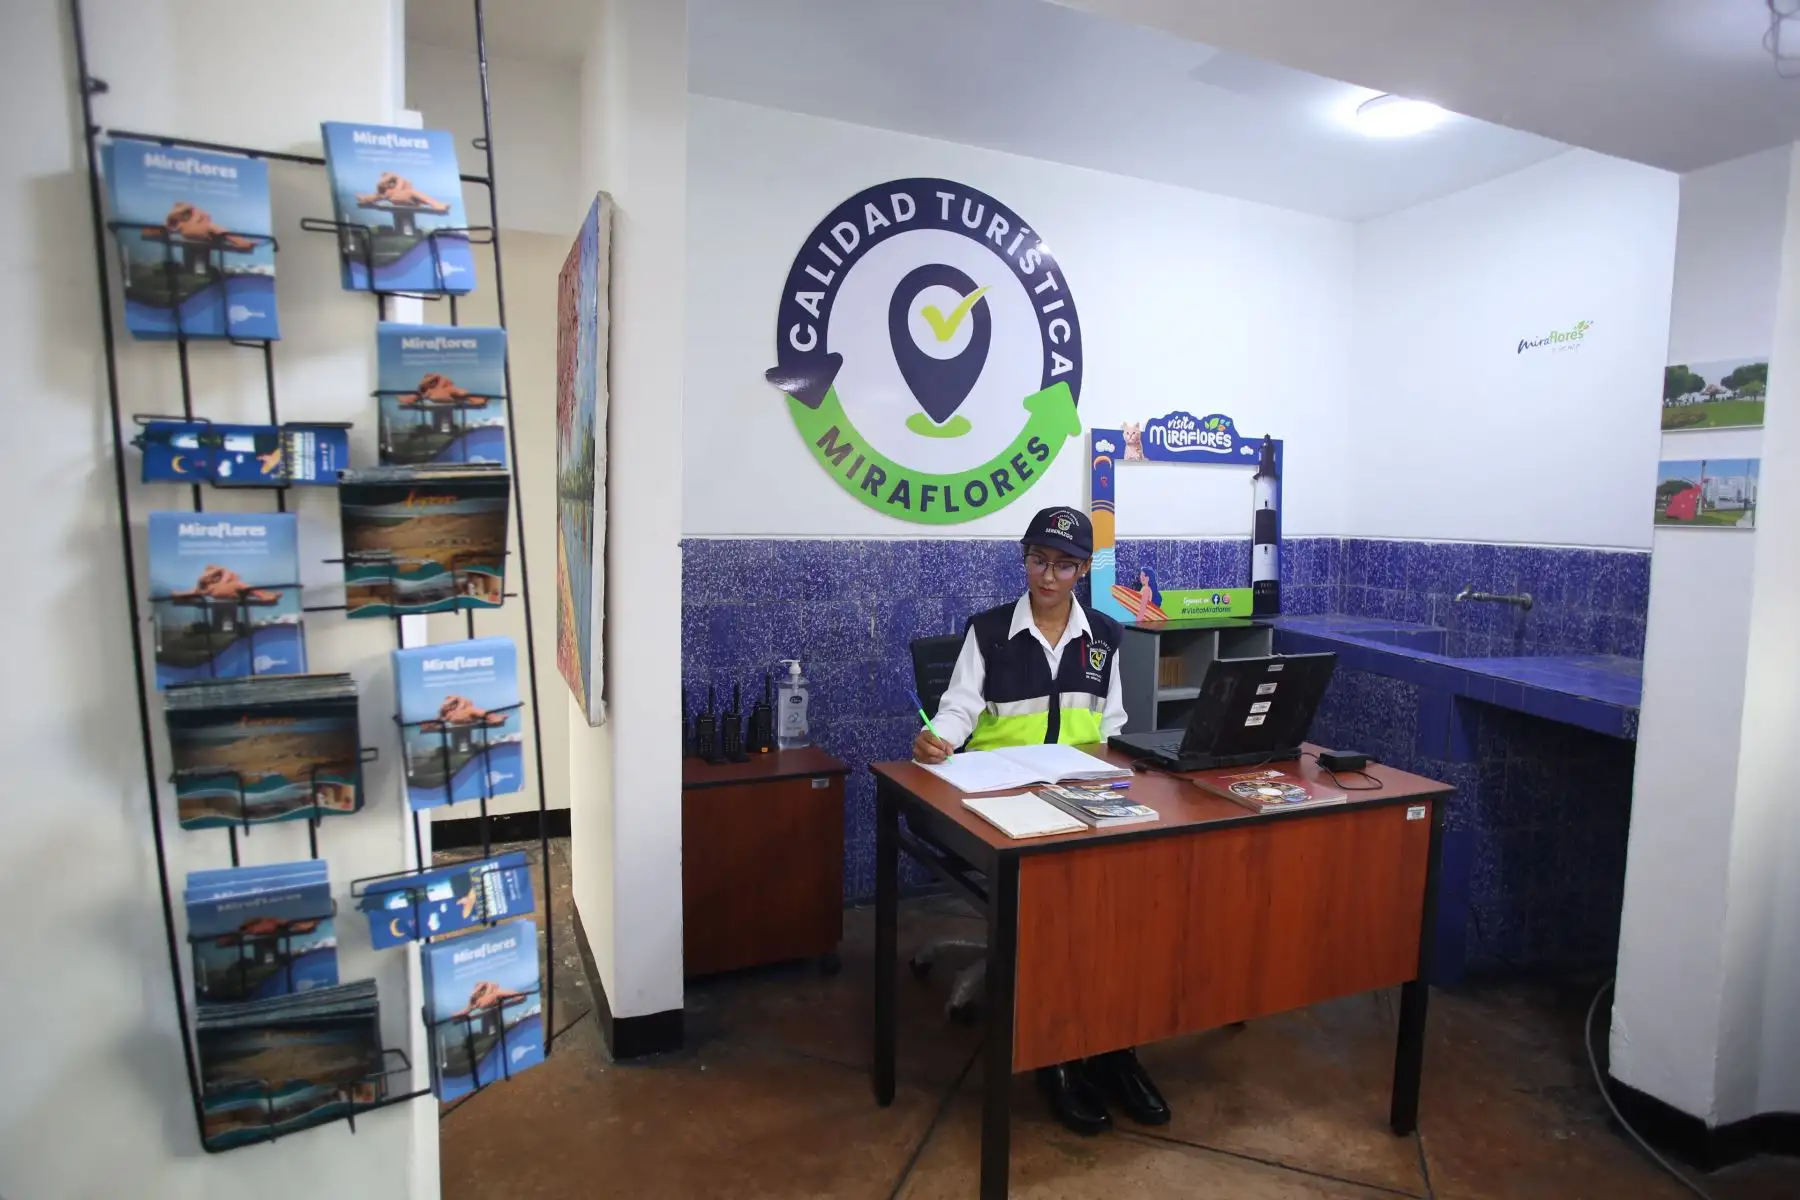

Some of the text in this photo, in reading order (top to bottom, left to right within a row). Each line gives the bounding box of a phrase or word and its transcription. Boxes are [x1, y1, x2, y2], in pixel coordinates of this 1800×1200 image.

[353, 130, 429, 149] Miraflores
[143, 152, 238, 179] Miraflores
[789, 191, 1074, 377] CALIDAD TURÍSTICA
[401, 336, 478, 351] Miraflores
[815, 425, 1050, 513] MIRAFLORES
[179, 522, 267, 539] Miraflores
[422, 656, 495, 671] Miraflores
[453, 937, 517, 964] Miraflores
